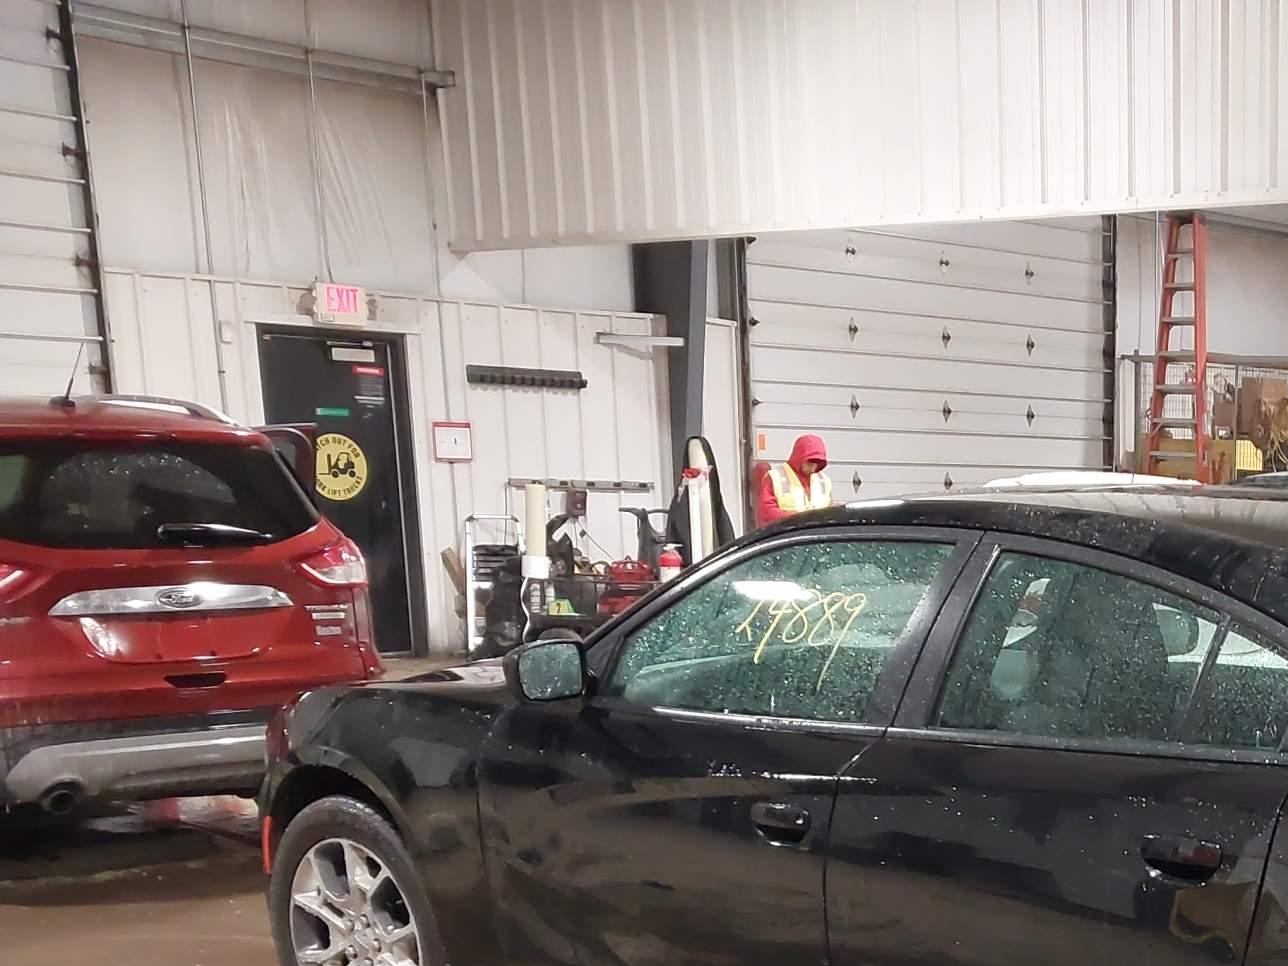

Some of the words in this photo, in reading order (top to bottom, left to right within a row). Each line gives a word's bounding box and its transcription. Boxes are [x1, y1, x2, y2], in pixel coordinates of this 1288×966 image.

[326, 286, 359, 313] EXIT
[331, 436, 347, 446] OUT
[348, 443, 361, 459] FOR
[327, 488, 341, 497] LIFT
